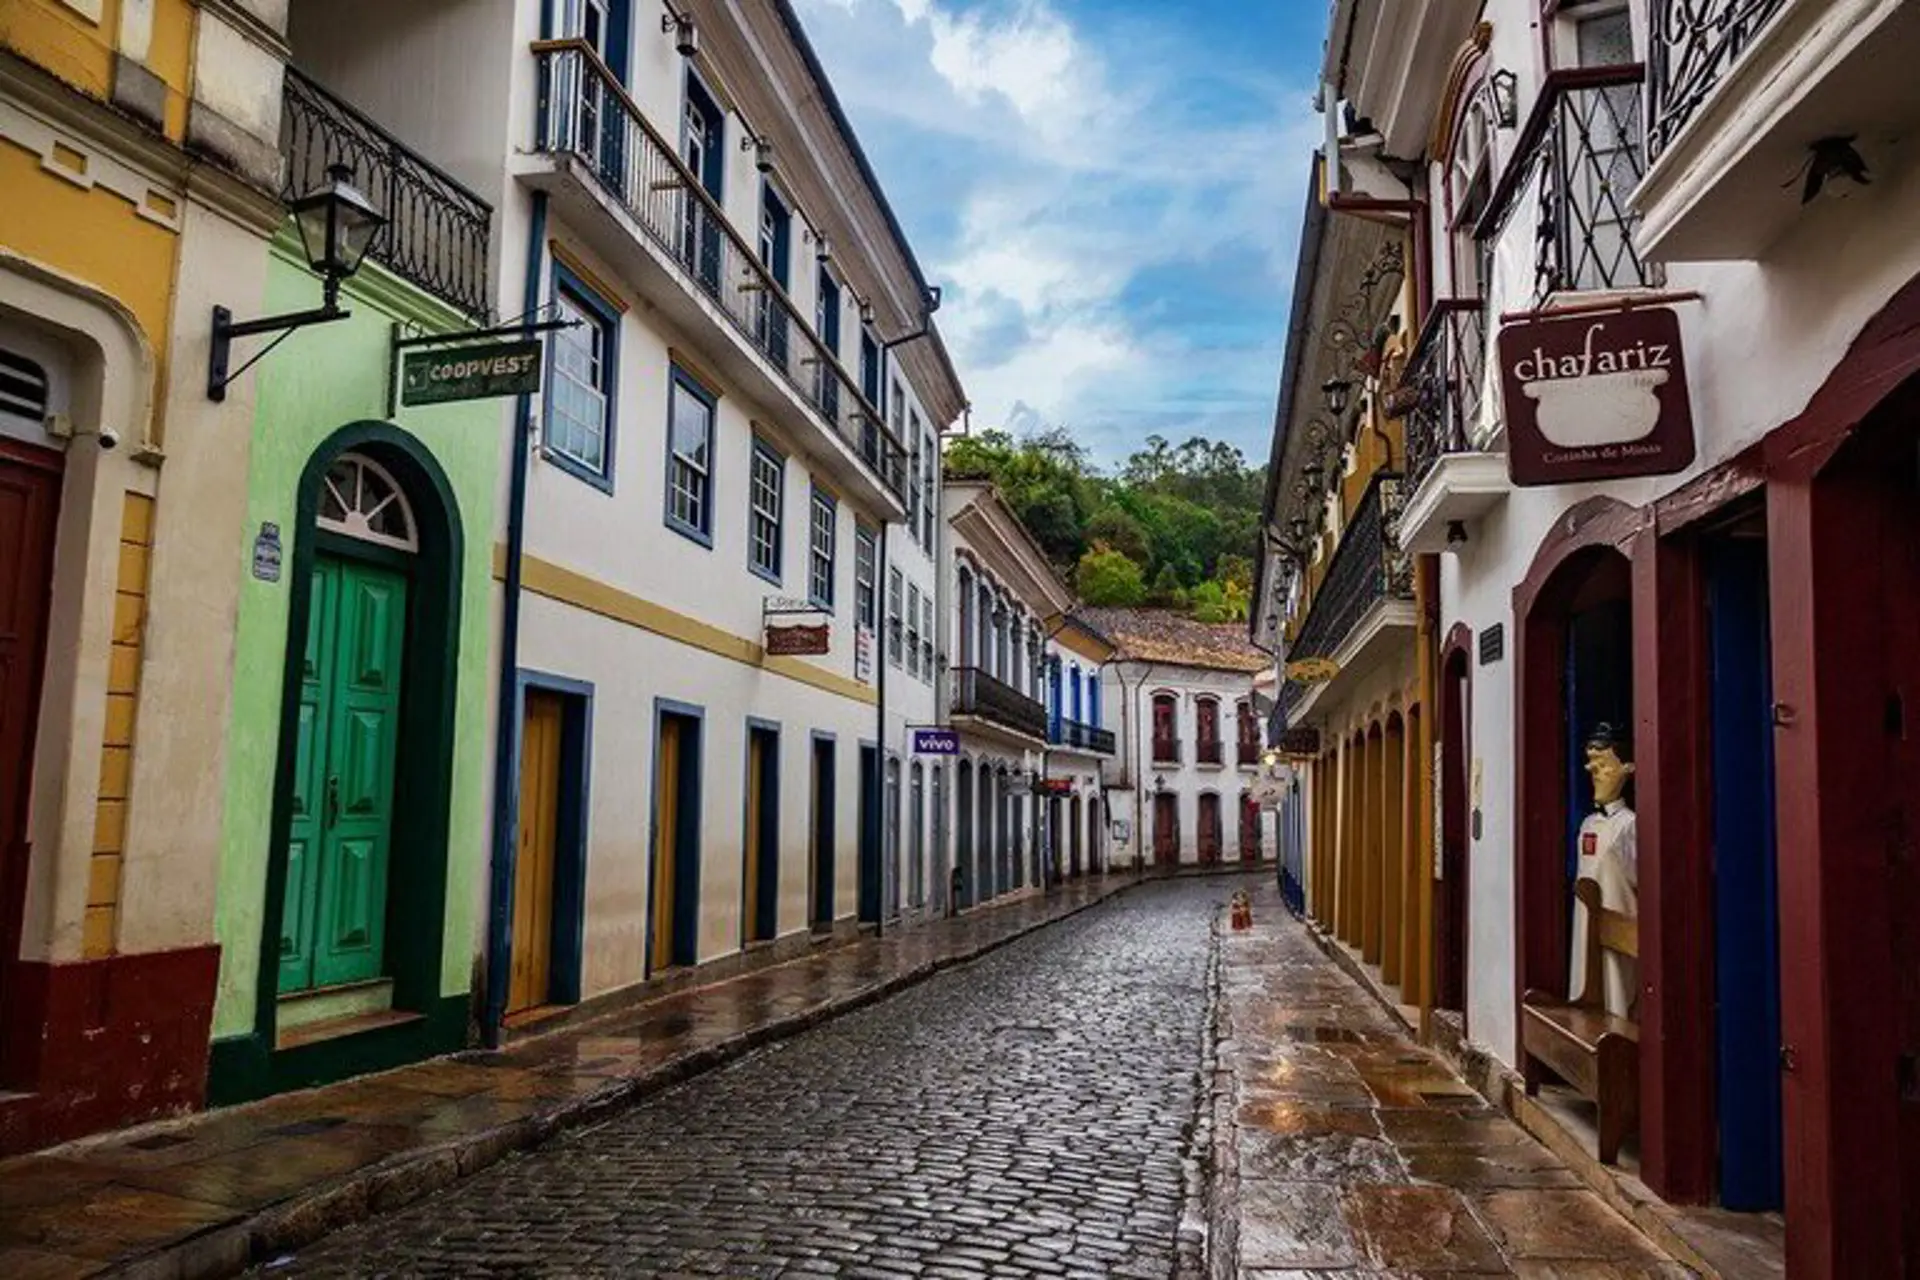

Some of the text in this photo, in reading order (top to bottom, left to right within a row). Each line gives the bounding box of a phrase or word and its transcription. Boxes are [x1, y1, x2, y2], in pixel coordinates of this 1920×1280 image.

[1514, 324, 1671, 380] chafariz
[430, 354, 535, 380] COOPVEST
[1600, 446, 1618, 459] de
[919, 734, 955, 751] vivo
